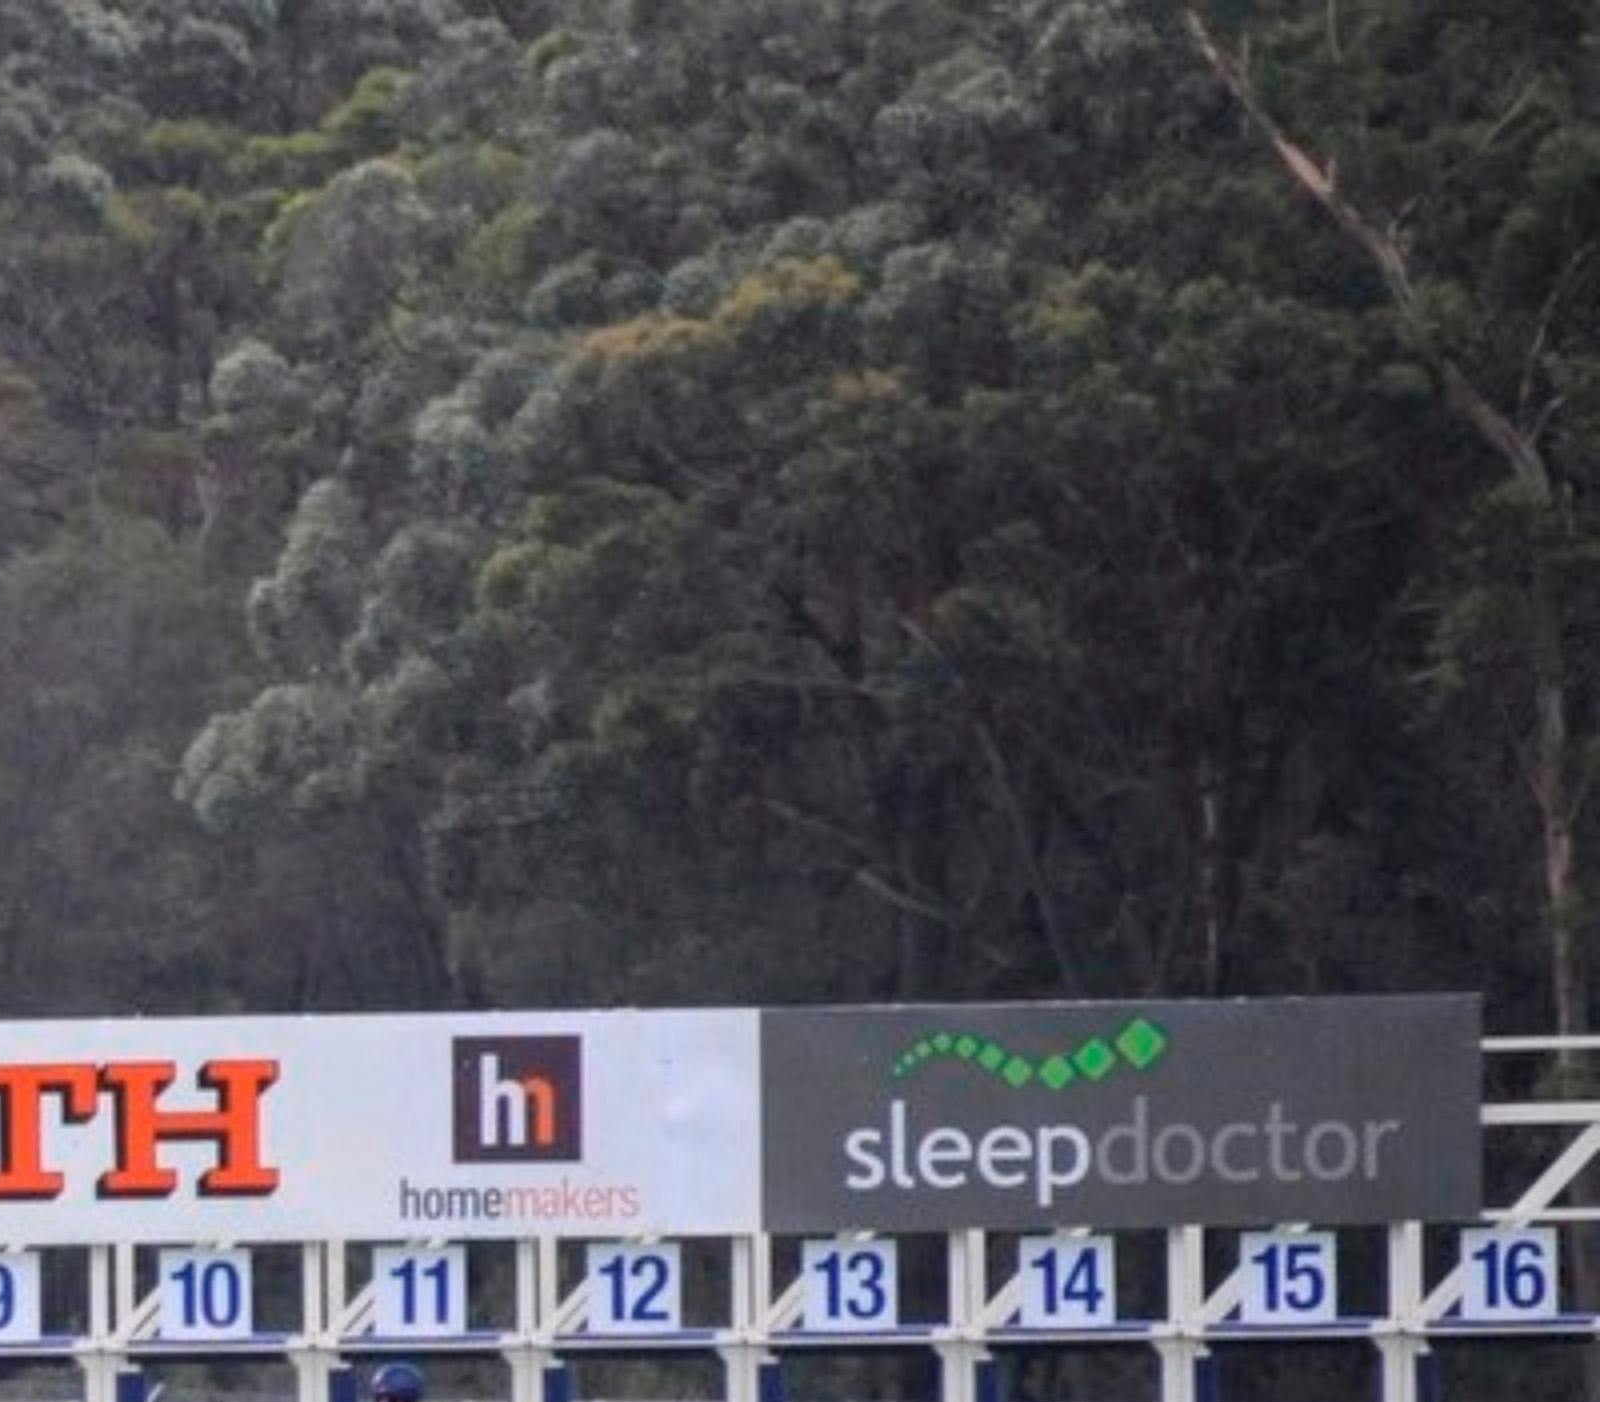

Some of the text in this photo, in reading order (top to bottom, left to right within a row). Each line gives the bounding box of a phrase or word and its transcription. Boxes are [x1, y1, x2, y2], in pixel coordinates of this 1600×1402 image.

[843, 1097, 1400, 1206] sleepdoctor
[400, 1177, 640, 1219] homemakers
[170, 1257, 241, 1328] 10
[389, 1256, 449, 1324] 11
[599, 1254, 670, 1321] 12
[812, 1249, 886, 1319] 13
[1031, 1246, 1102, 1315] 14
[1251, 1242, 1325, 1313] 15
[1472, 1239, 1546, 1309] 16
